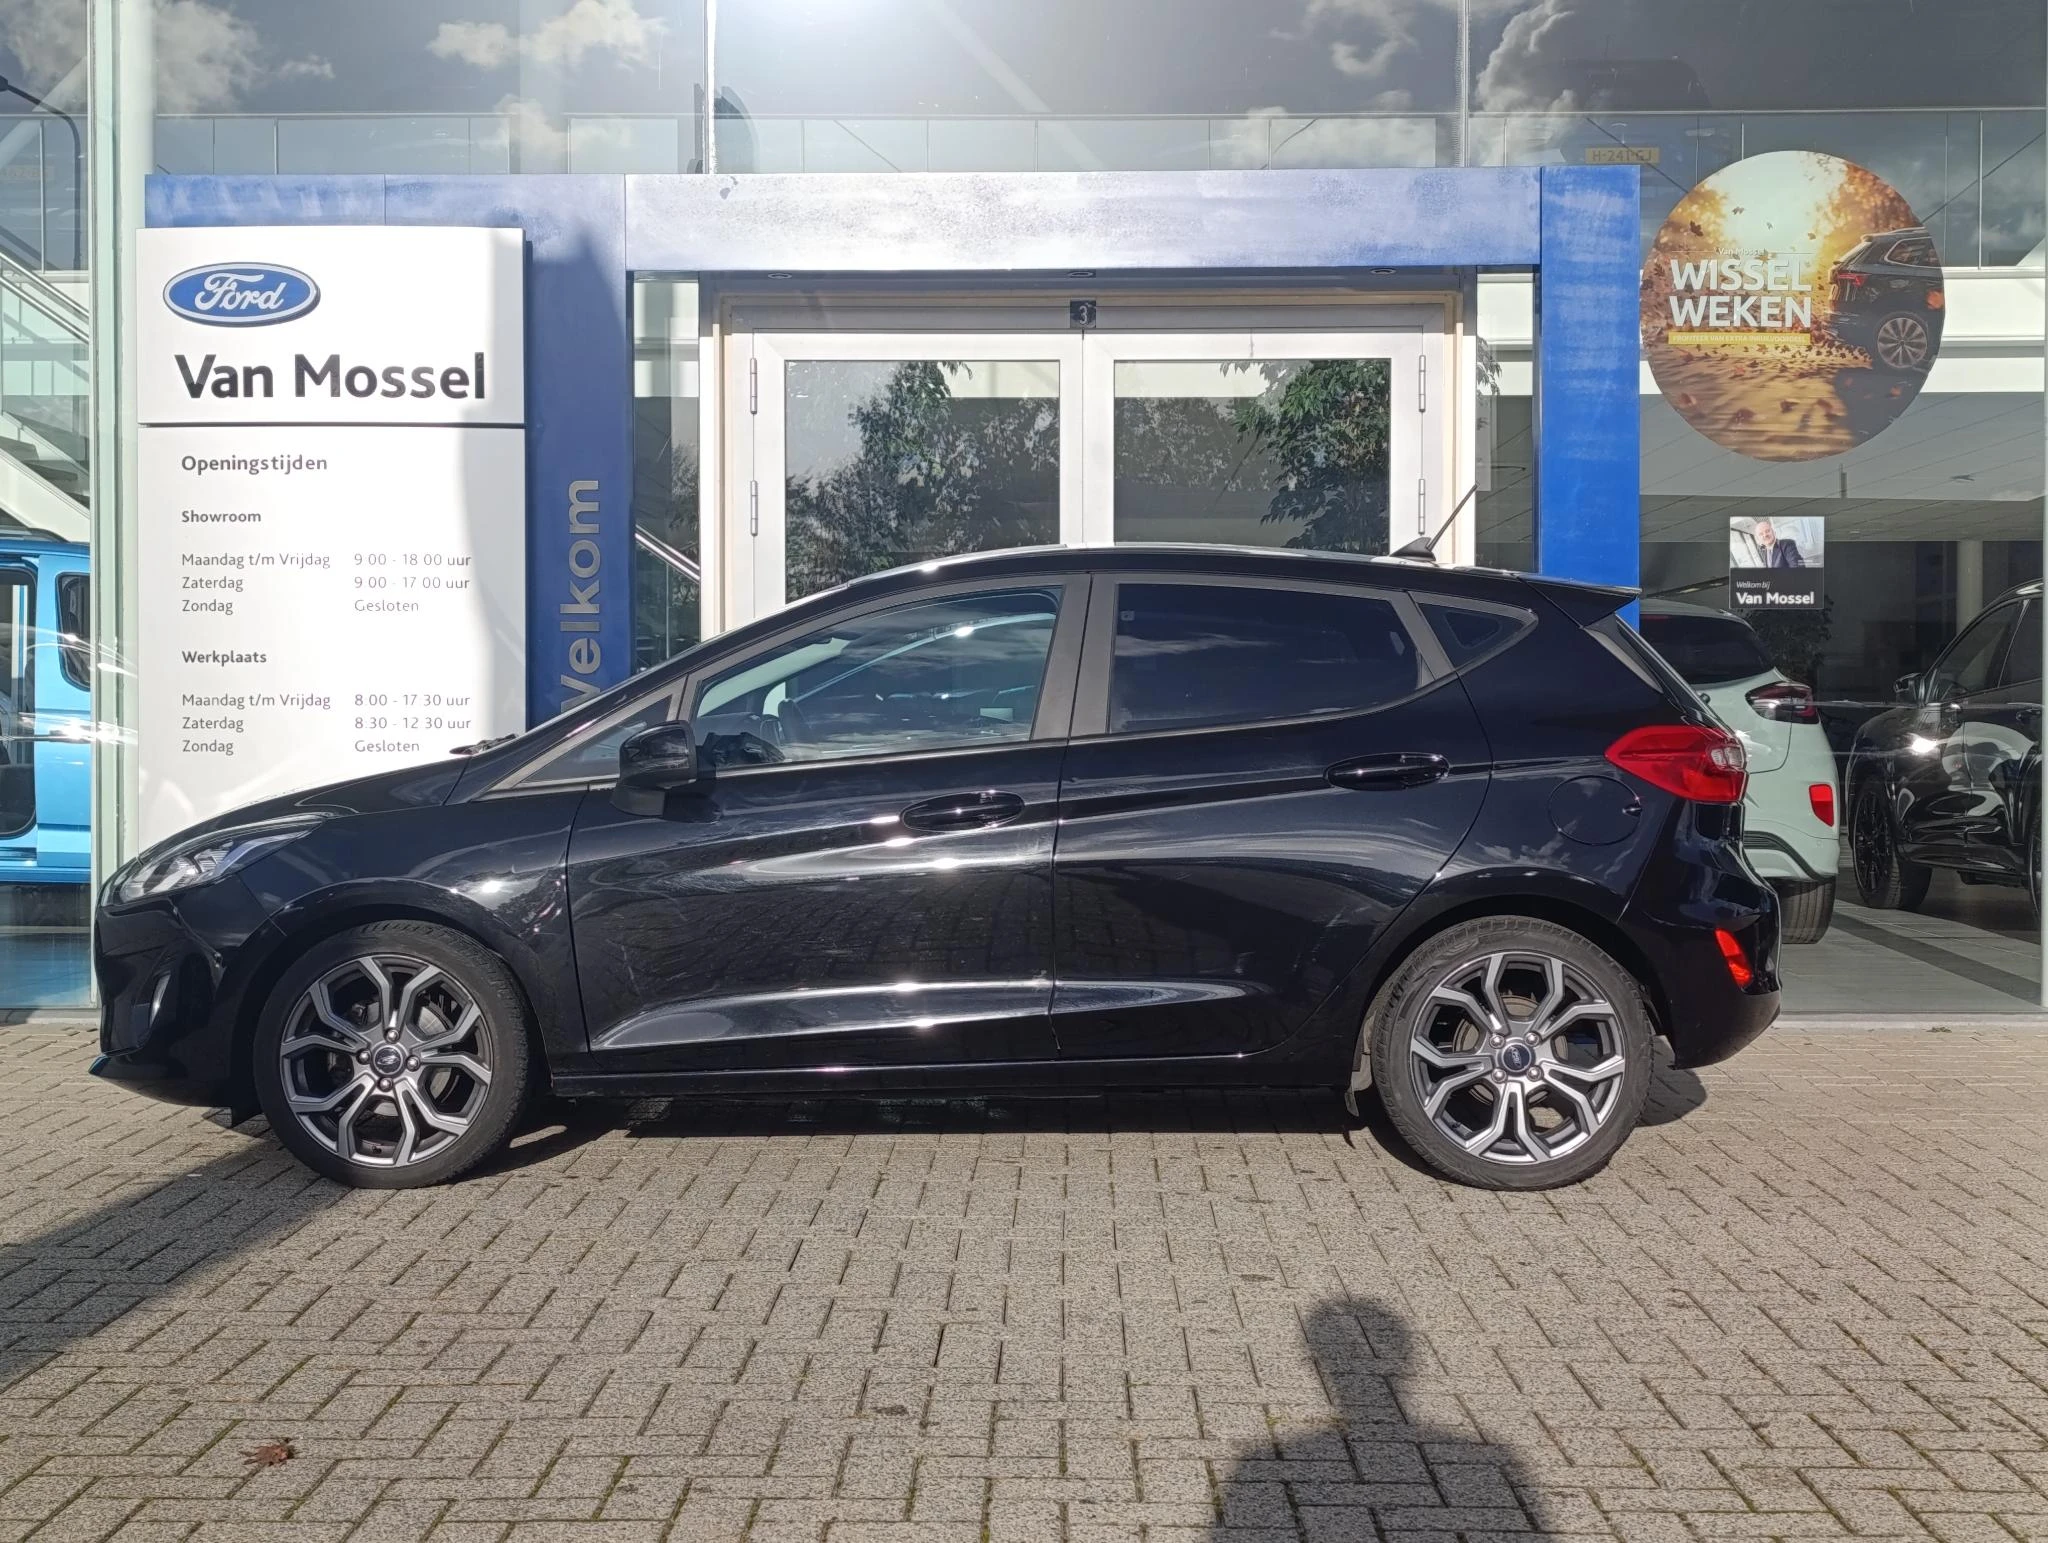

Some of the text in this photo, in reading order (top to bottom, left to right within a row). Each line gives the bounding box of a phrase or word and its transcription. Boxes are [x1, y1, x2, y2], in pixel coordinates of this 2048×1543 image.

[1670, 258, 1812, 291] WISSEL
[194, 272, 288, 310] Ford
[1079, 305, 1088, 325] 3
[1668, 295, 1812, 328] WEKEN
[175, 353, 484, 398] Van Mossel
[182, 455, 328, 475] Openingstijden
[182, 510, 261, 522] Showroom
[182, 553, 330, 569] Maandag t/m Vrijdag
[354, 553, 387, 566] 900
[403, 554, 442, 565] 1800
[448, 556, 472, 566] uur
[182, 576, 243, 592] Zaterdag
[354, 577, 387, 589] 900
[404, 577, 440, 588] 1700
[446, 579, 471, 589] uur
[355, 600, 418, 611] Gesloten
[1736, 591, 1814, 605] Van Mossel
[182, 599, 233, 615] Zondag
[182, 650, 266, 667] Werkplaats
[182, 693, 330, 710] Maandag t/m Vrijdag
[403, 694, 441, 706] 1730
[447, 697, 470, 706] uur
[182, 717, 244, 733] Zaterdag
[403, 717, 442, 729] 1230
[448, 720, 471, 728] uur
[182, 740, 234, 756] Zondag
[355, 740, 419, 752] Gesloten
